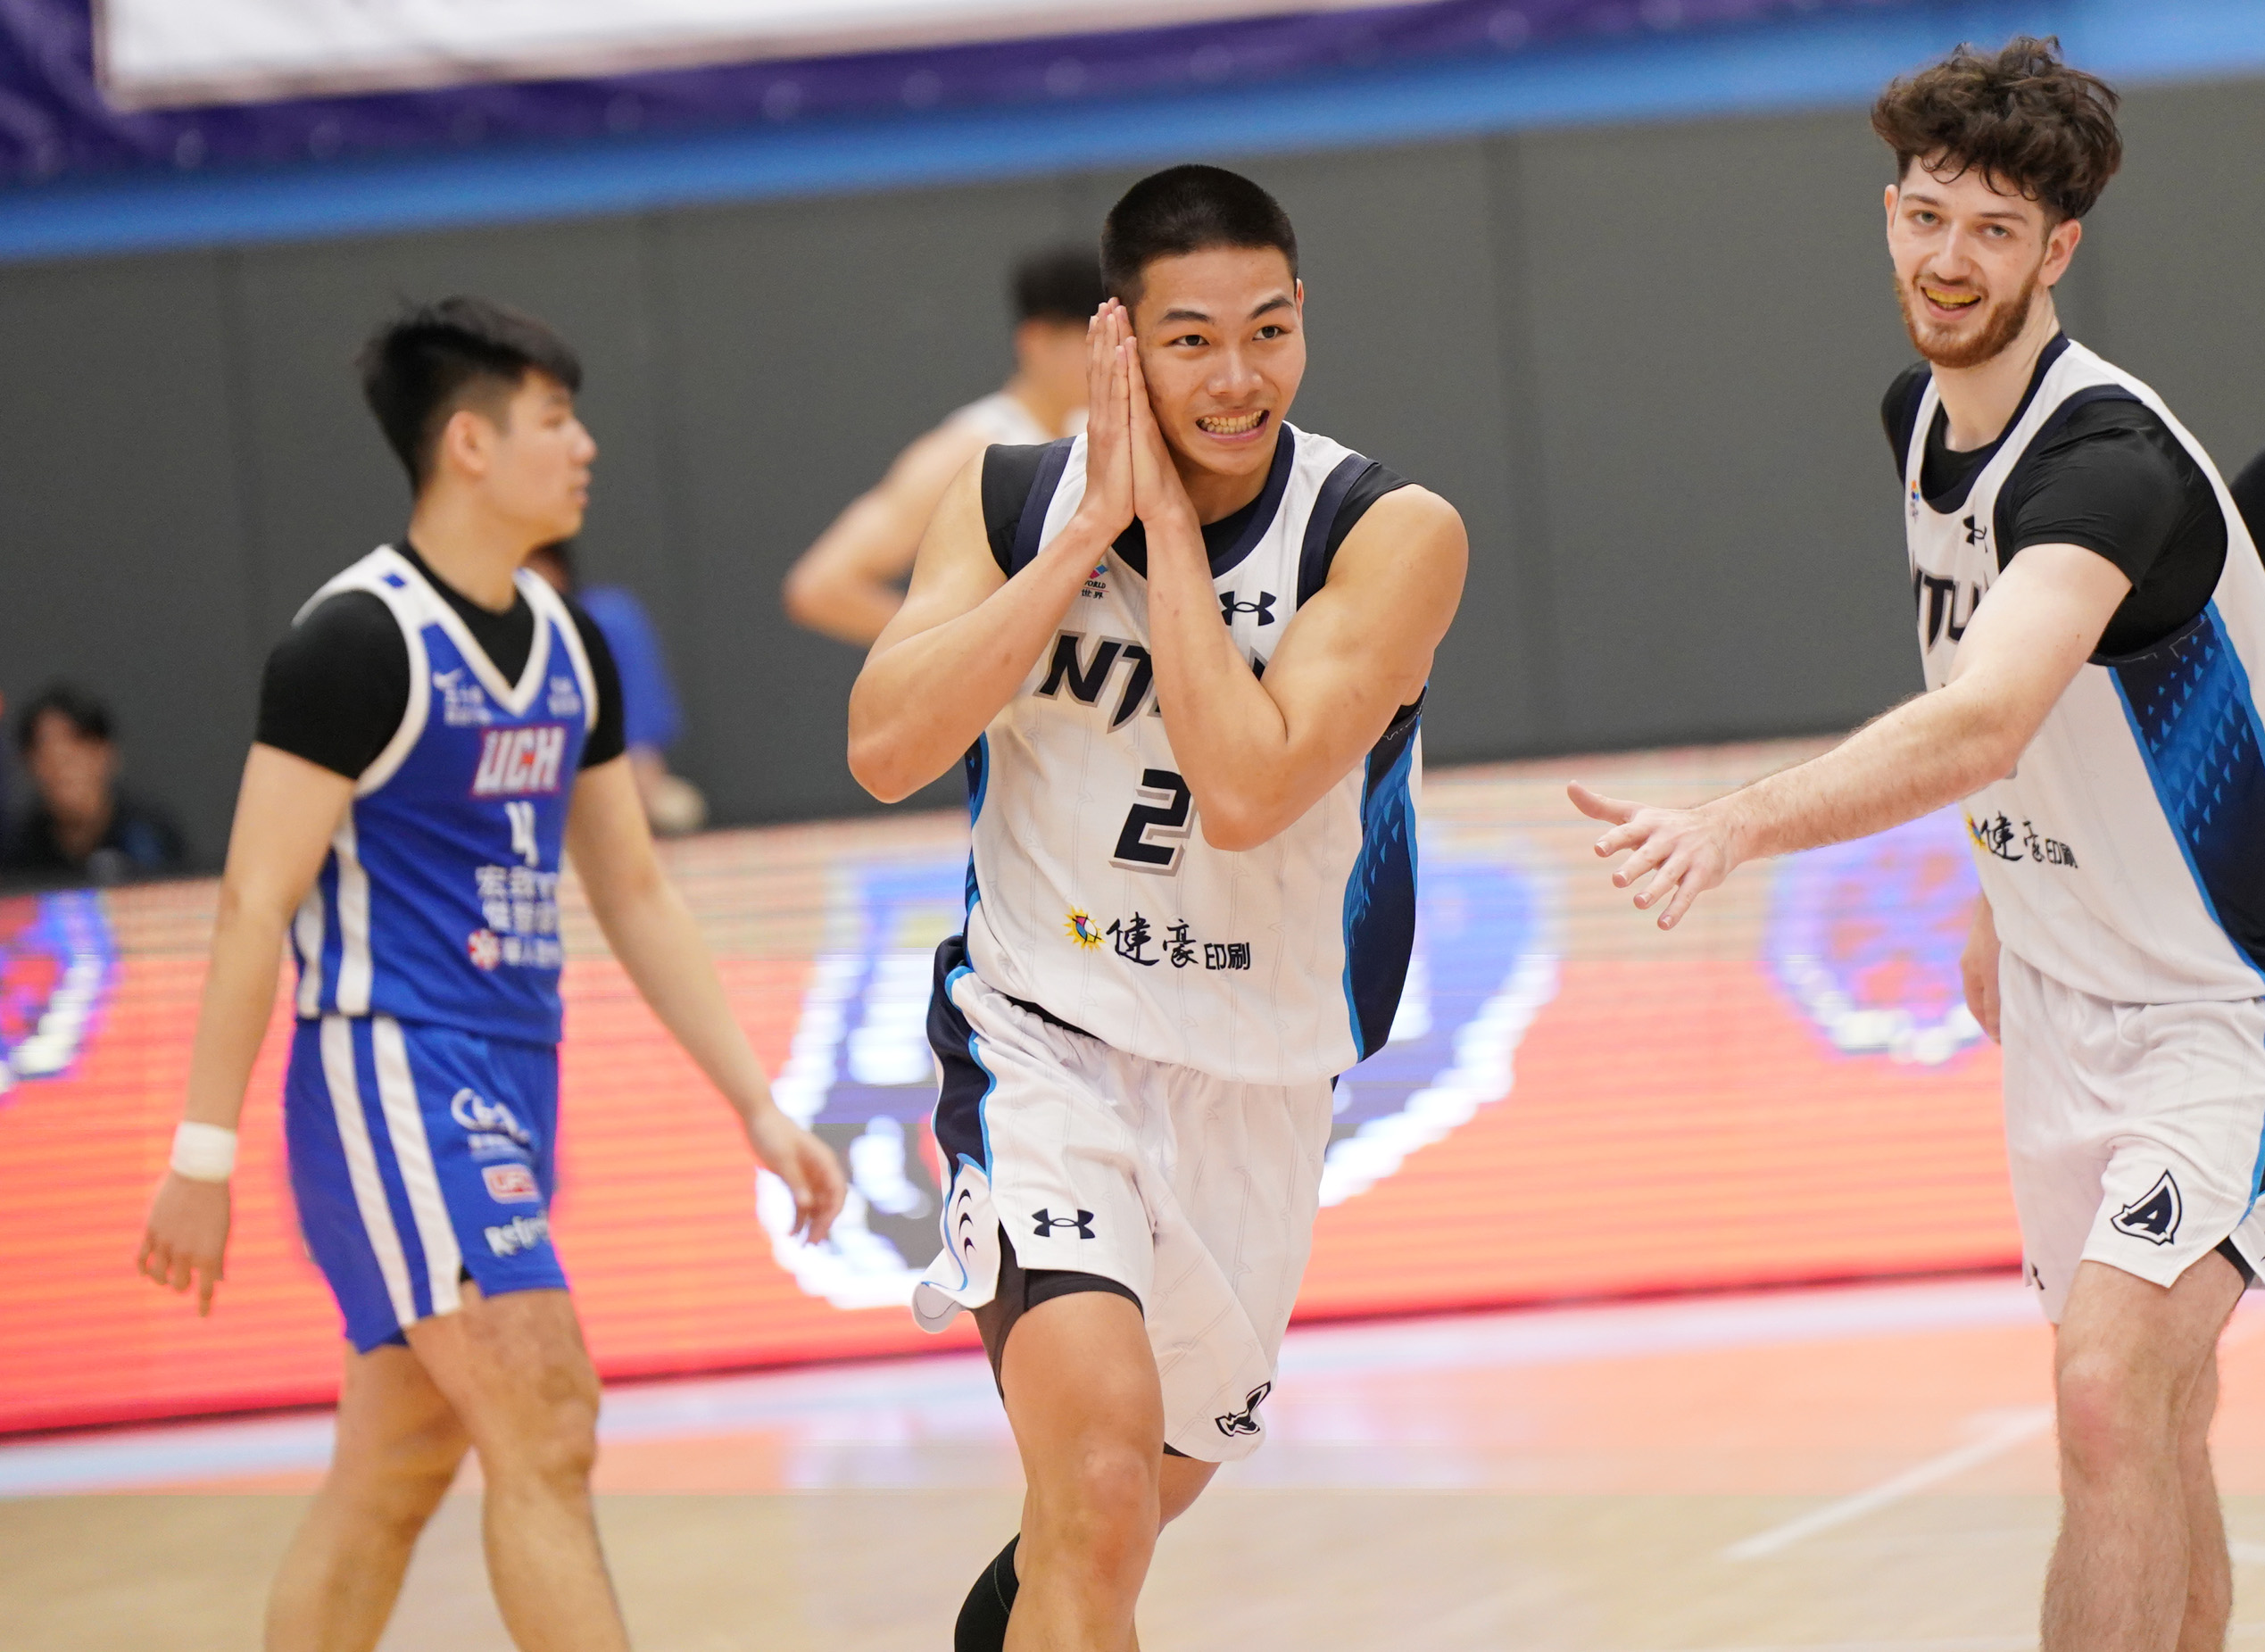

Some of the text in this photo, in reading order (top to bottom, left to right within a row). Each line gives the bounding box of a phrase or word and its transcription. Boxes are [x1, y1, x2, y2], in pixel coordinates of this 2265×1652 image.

[473, 726, 566, 796] UCH
[504, 801, 540, 868] 4
[1108, 768, 1198, 877] 2
